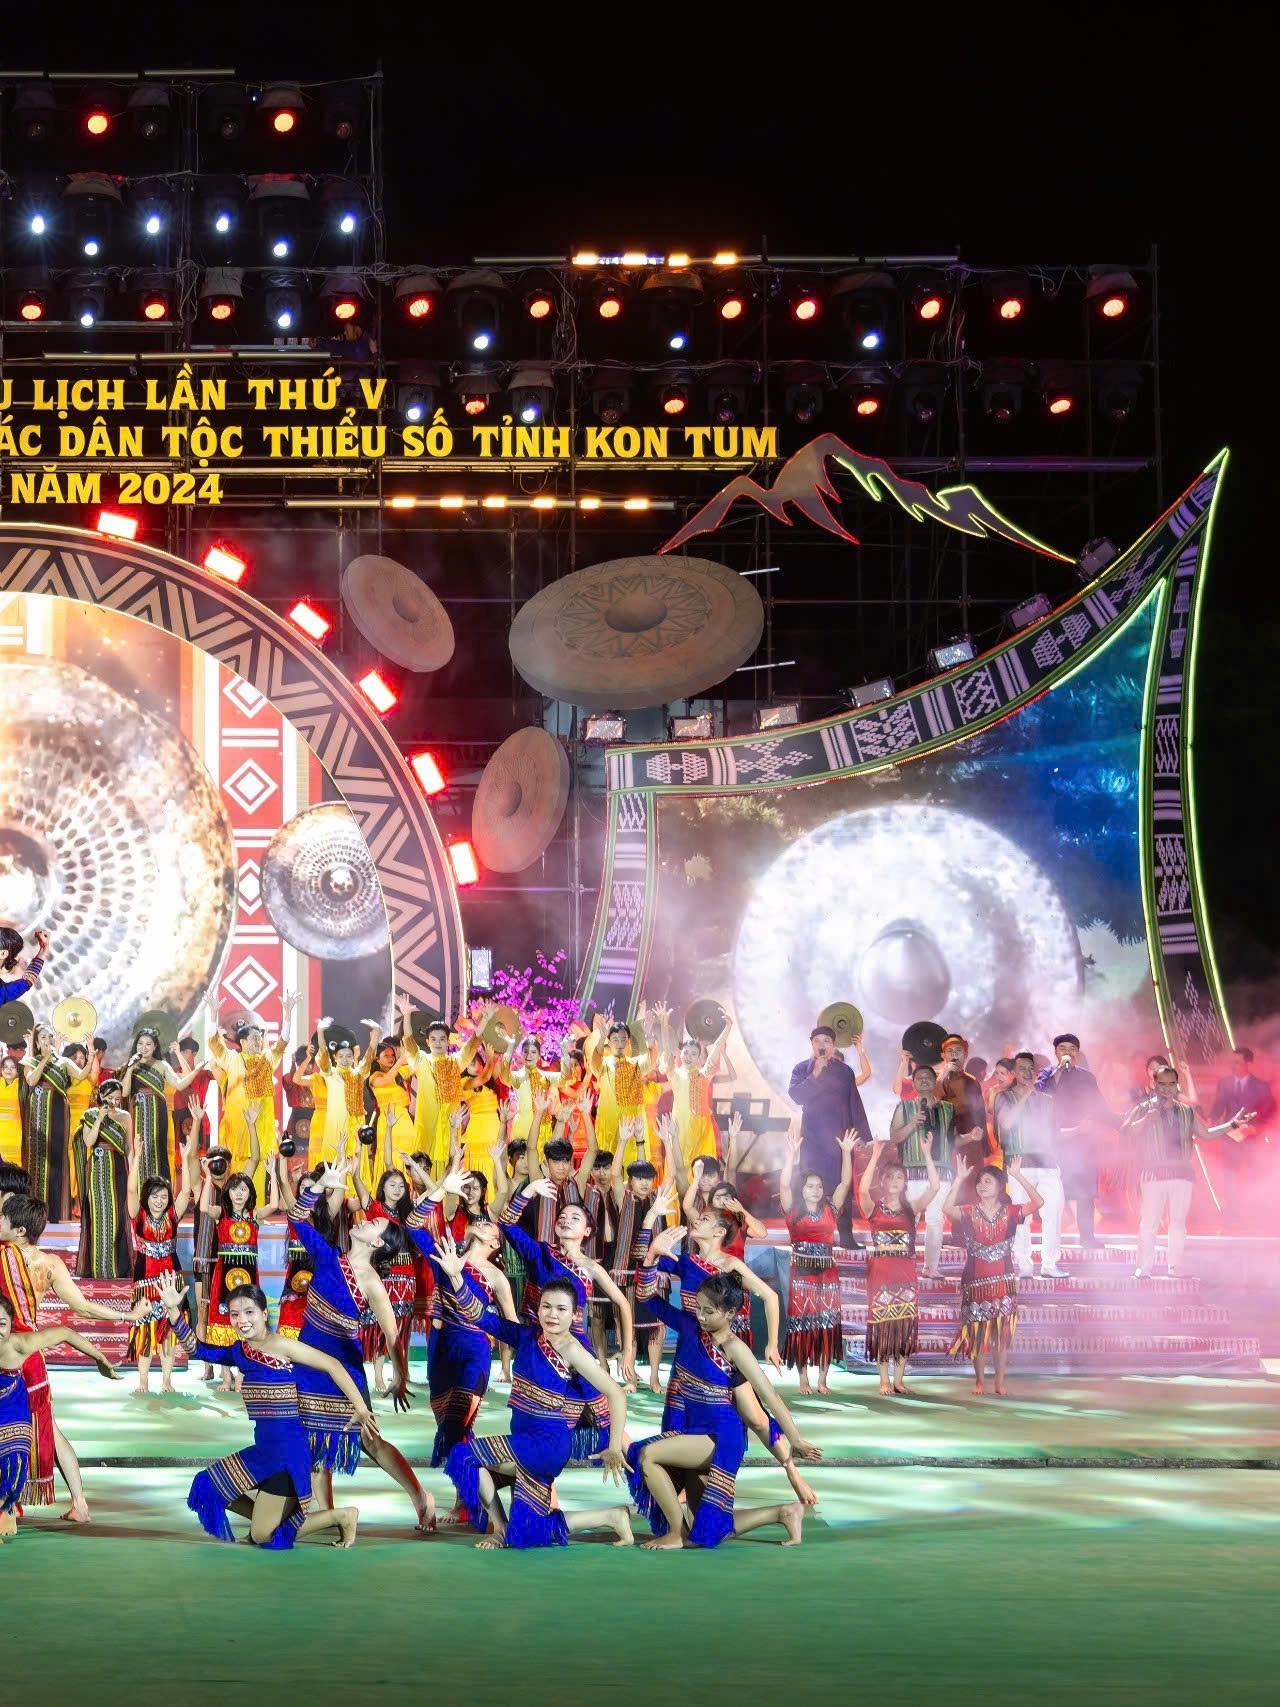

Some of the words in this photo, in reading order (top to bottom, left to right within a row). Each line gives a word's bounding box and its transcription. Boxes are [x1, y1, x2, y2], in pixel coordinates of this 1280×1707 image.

[32, 379, 125, 420] LỊCH
[146, 363, 226, 411] LẦN
[247, 367, 342, 411] THỨ
[359, 378, 388, 410] V
[58, 417, 144, 457] DÂN
[161, 417, 245, 468] TỘC
[263, 407, 388, 458] THIỂU
[403, 408, 454, 458] SỐ
[472, 415, 571, 458] TỈNH
[585, 426, 670, 458] KON
[684, 426, 779, 458] TUM
[10, 464, 103, 504] NĂM
[119, 472, 224, 505] 2024
